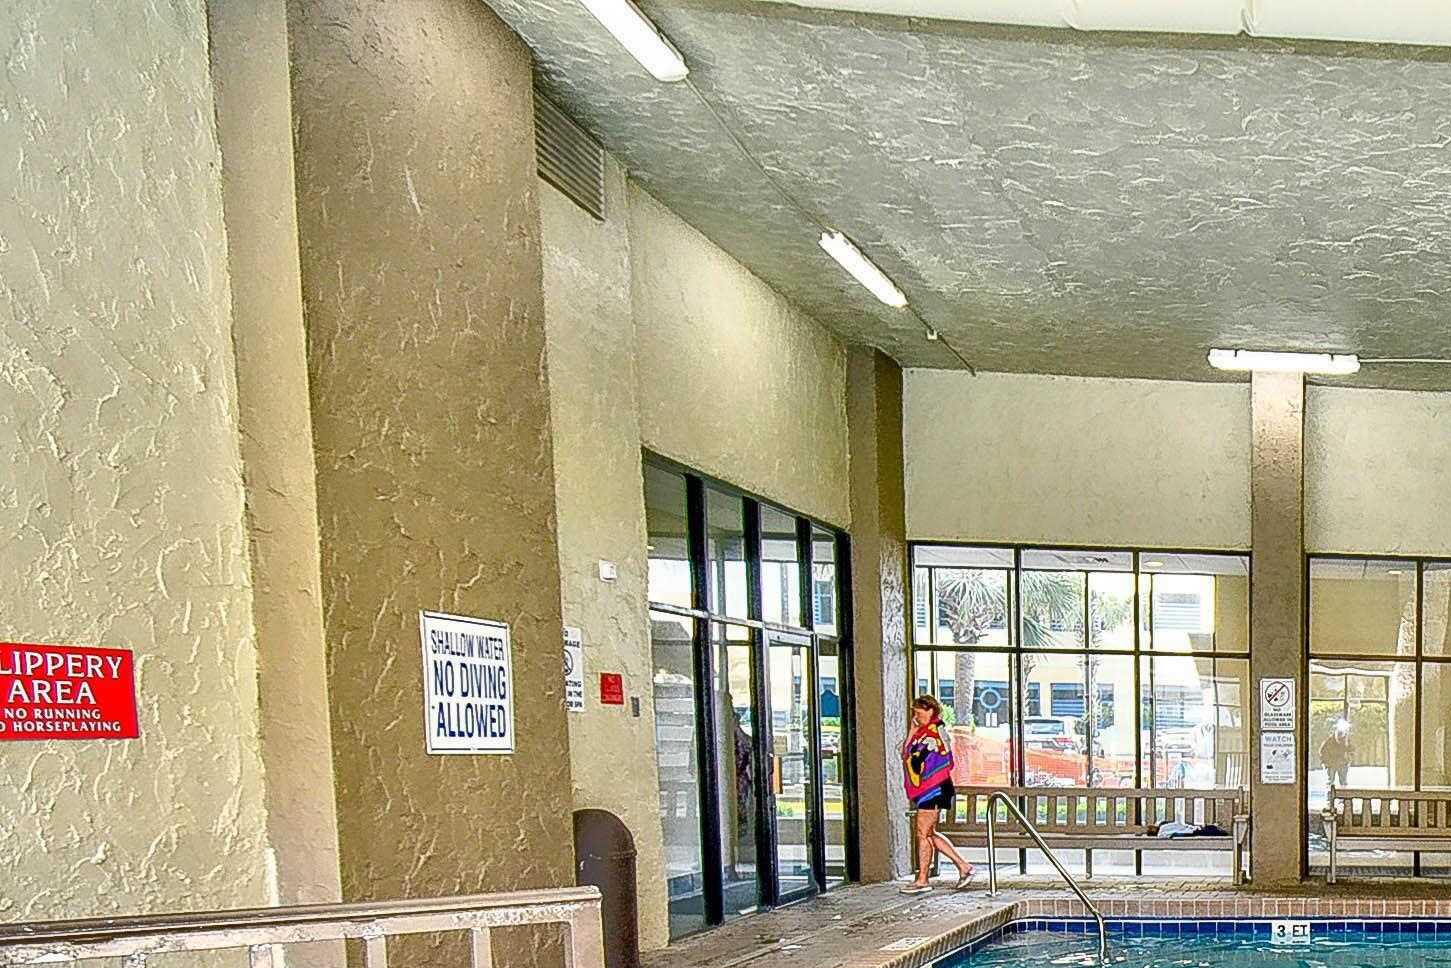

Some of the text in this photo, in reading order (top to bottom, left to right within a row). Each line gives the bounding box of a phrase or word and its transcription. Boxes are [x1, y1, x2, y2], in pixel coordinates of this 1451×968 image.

[431, 629, 505, 660] SHALLOW WATER
[0, 651, 122, 679] LIPPERY
[8, 680, 97, 704] AREA
[433, 660, 506, 700] NO DIVING
[4, 708, 101, 720] NO RUNNING
[13, 721, 121, 732] HORSEPLAYING
[437, 702, 506, 738] ALLOWED
[1277, 924, 1286, 937] 3
